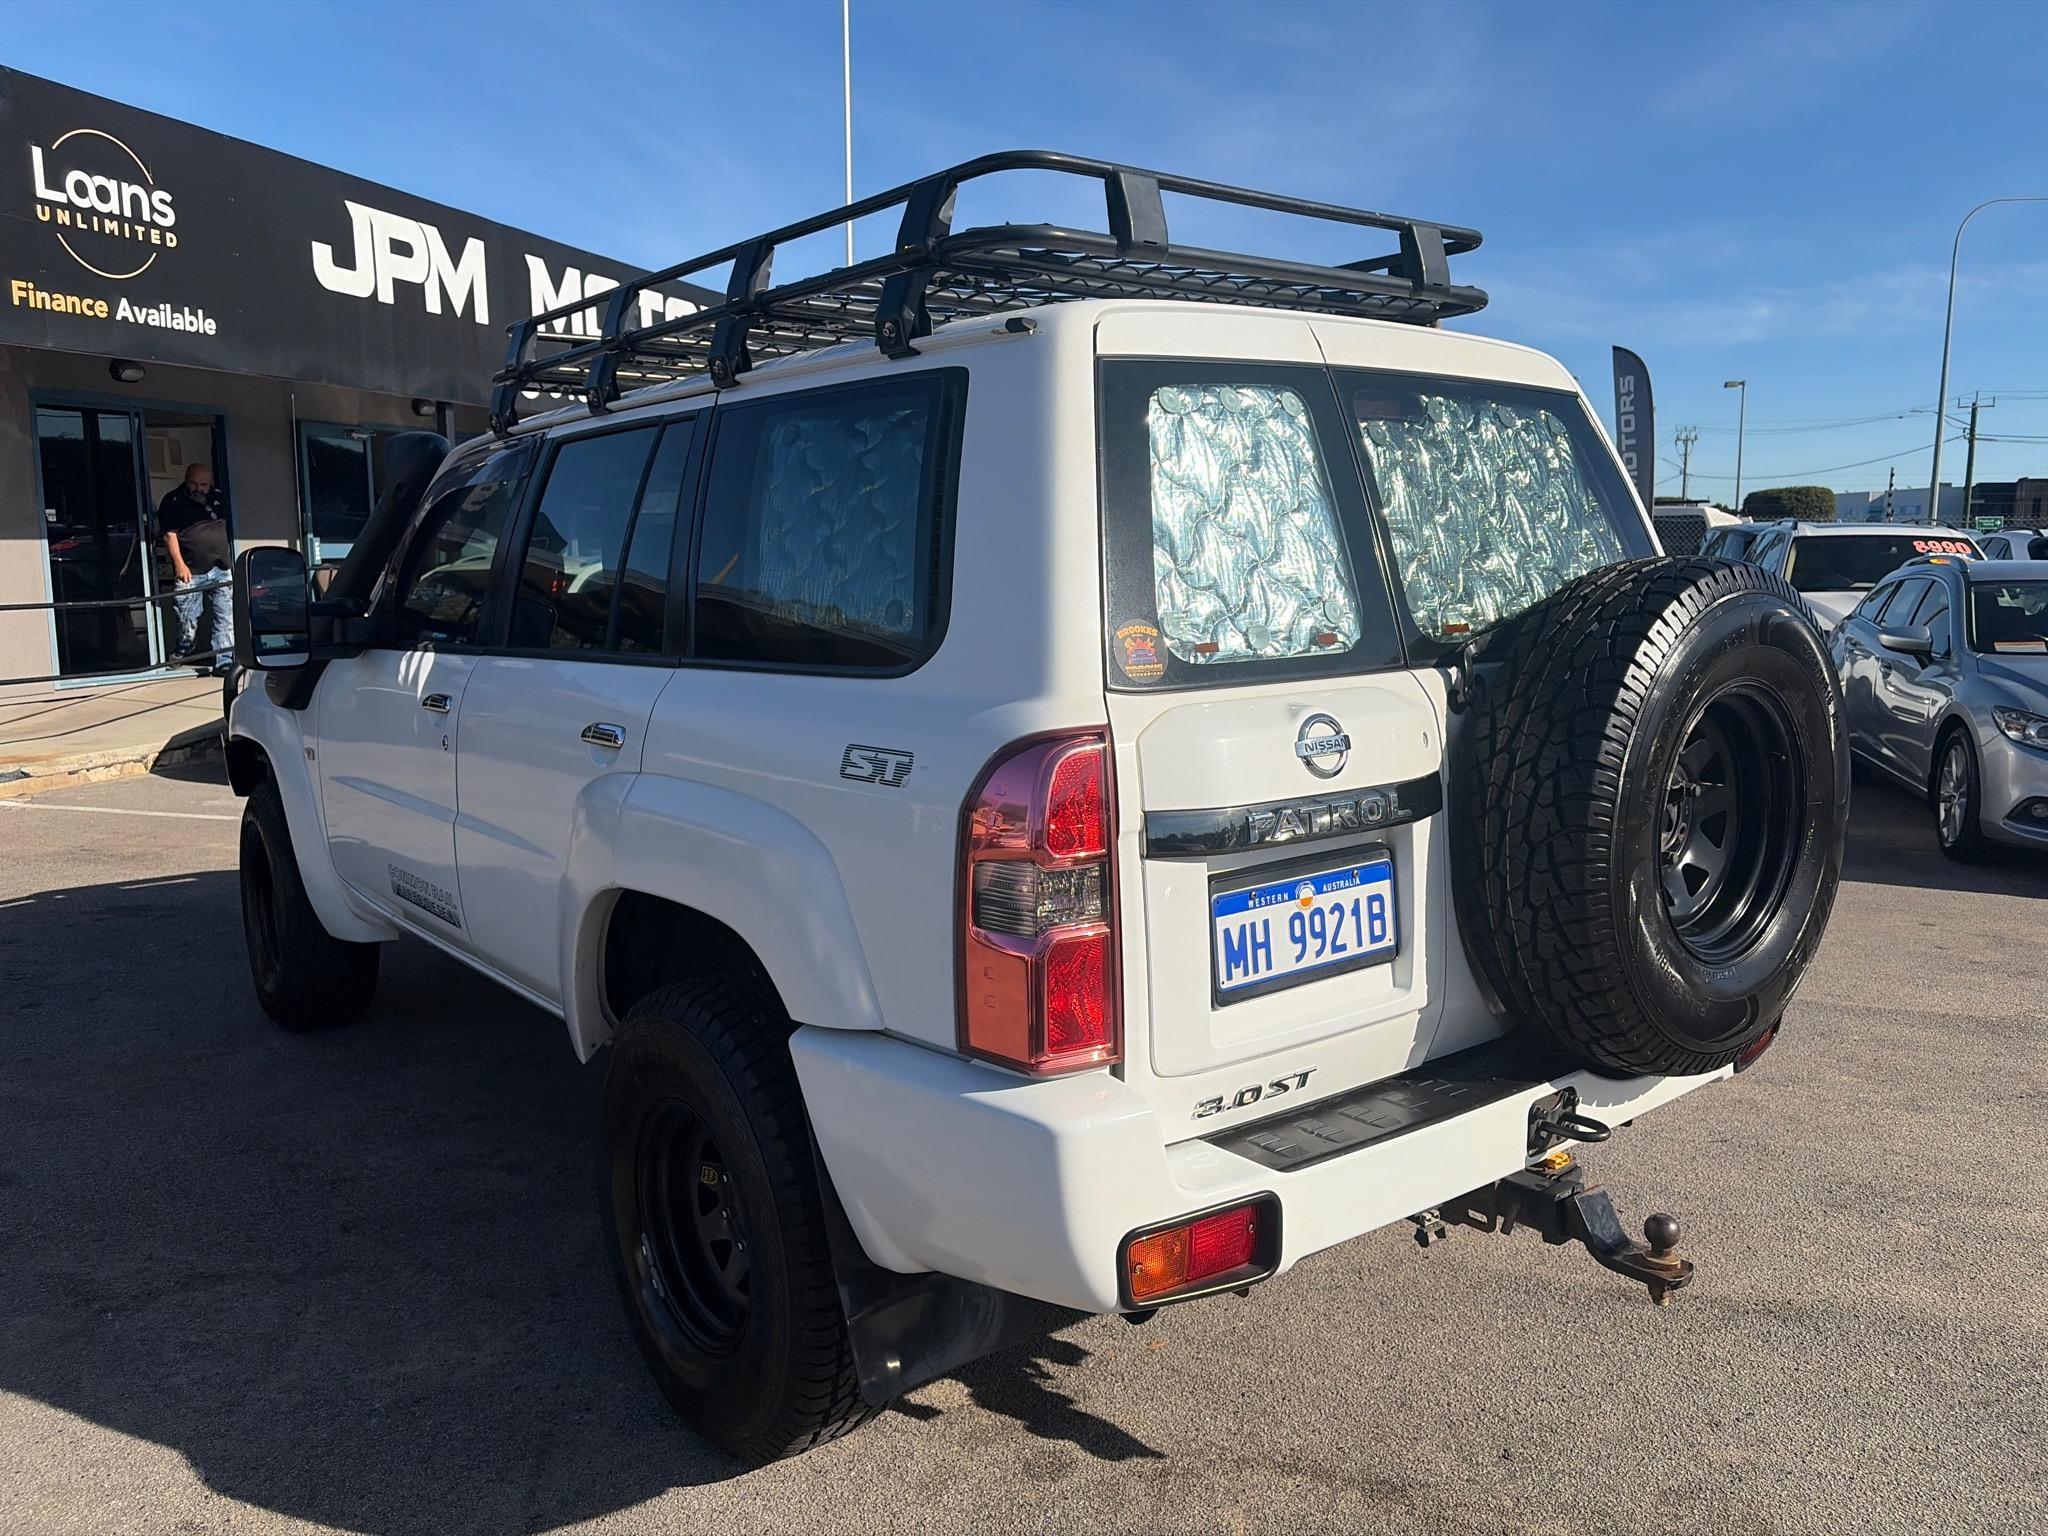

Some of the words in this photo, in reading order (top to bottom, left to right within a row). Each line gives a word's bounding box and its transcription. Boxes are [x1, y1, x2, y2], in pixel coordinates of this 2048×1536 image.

[31, 144, 177, 228] Loans
[35, 203, 178, 249] UNLIMITED
[311, 200, 490, 326] JPM
[524, 253, 709, 341] MOT
[11, 279, 109, 319] Finance
[115, 296, 218, 336] Available
[1619, 375, 1639, 490] OTORS
[1117, 626, 1158, 638] BROOKES
[842, 746, 913, 785] ST
[1304, 736, 1350, 754] NISSAN
[1247, 791, 1413, 843] PATROL
[1247, 892, 1289, 909] WESTERN
[1322, 876, 1361, 893] AUSTRALIA
[1223, 918, 1273, 982] MH
[1288, 892, 1388, 964] 9921B
